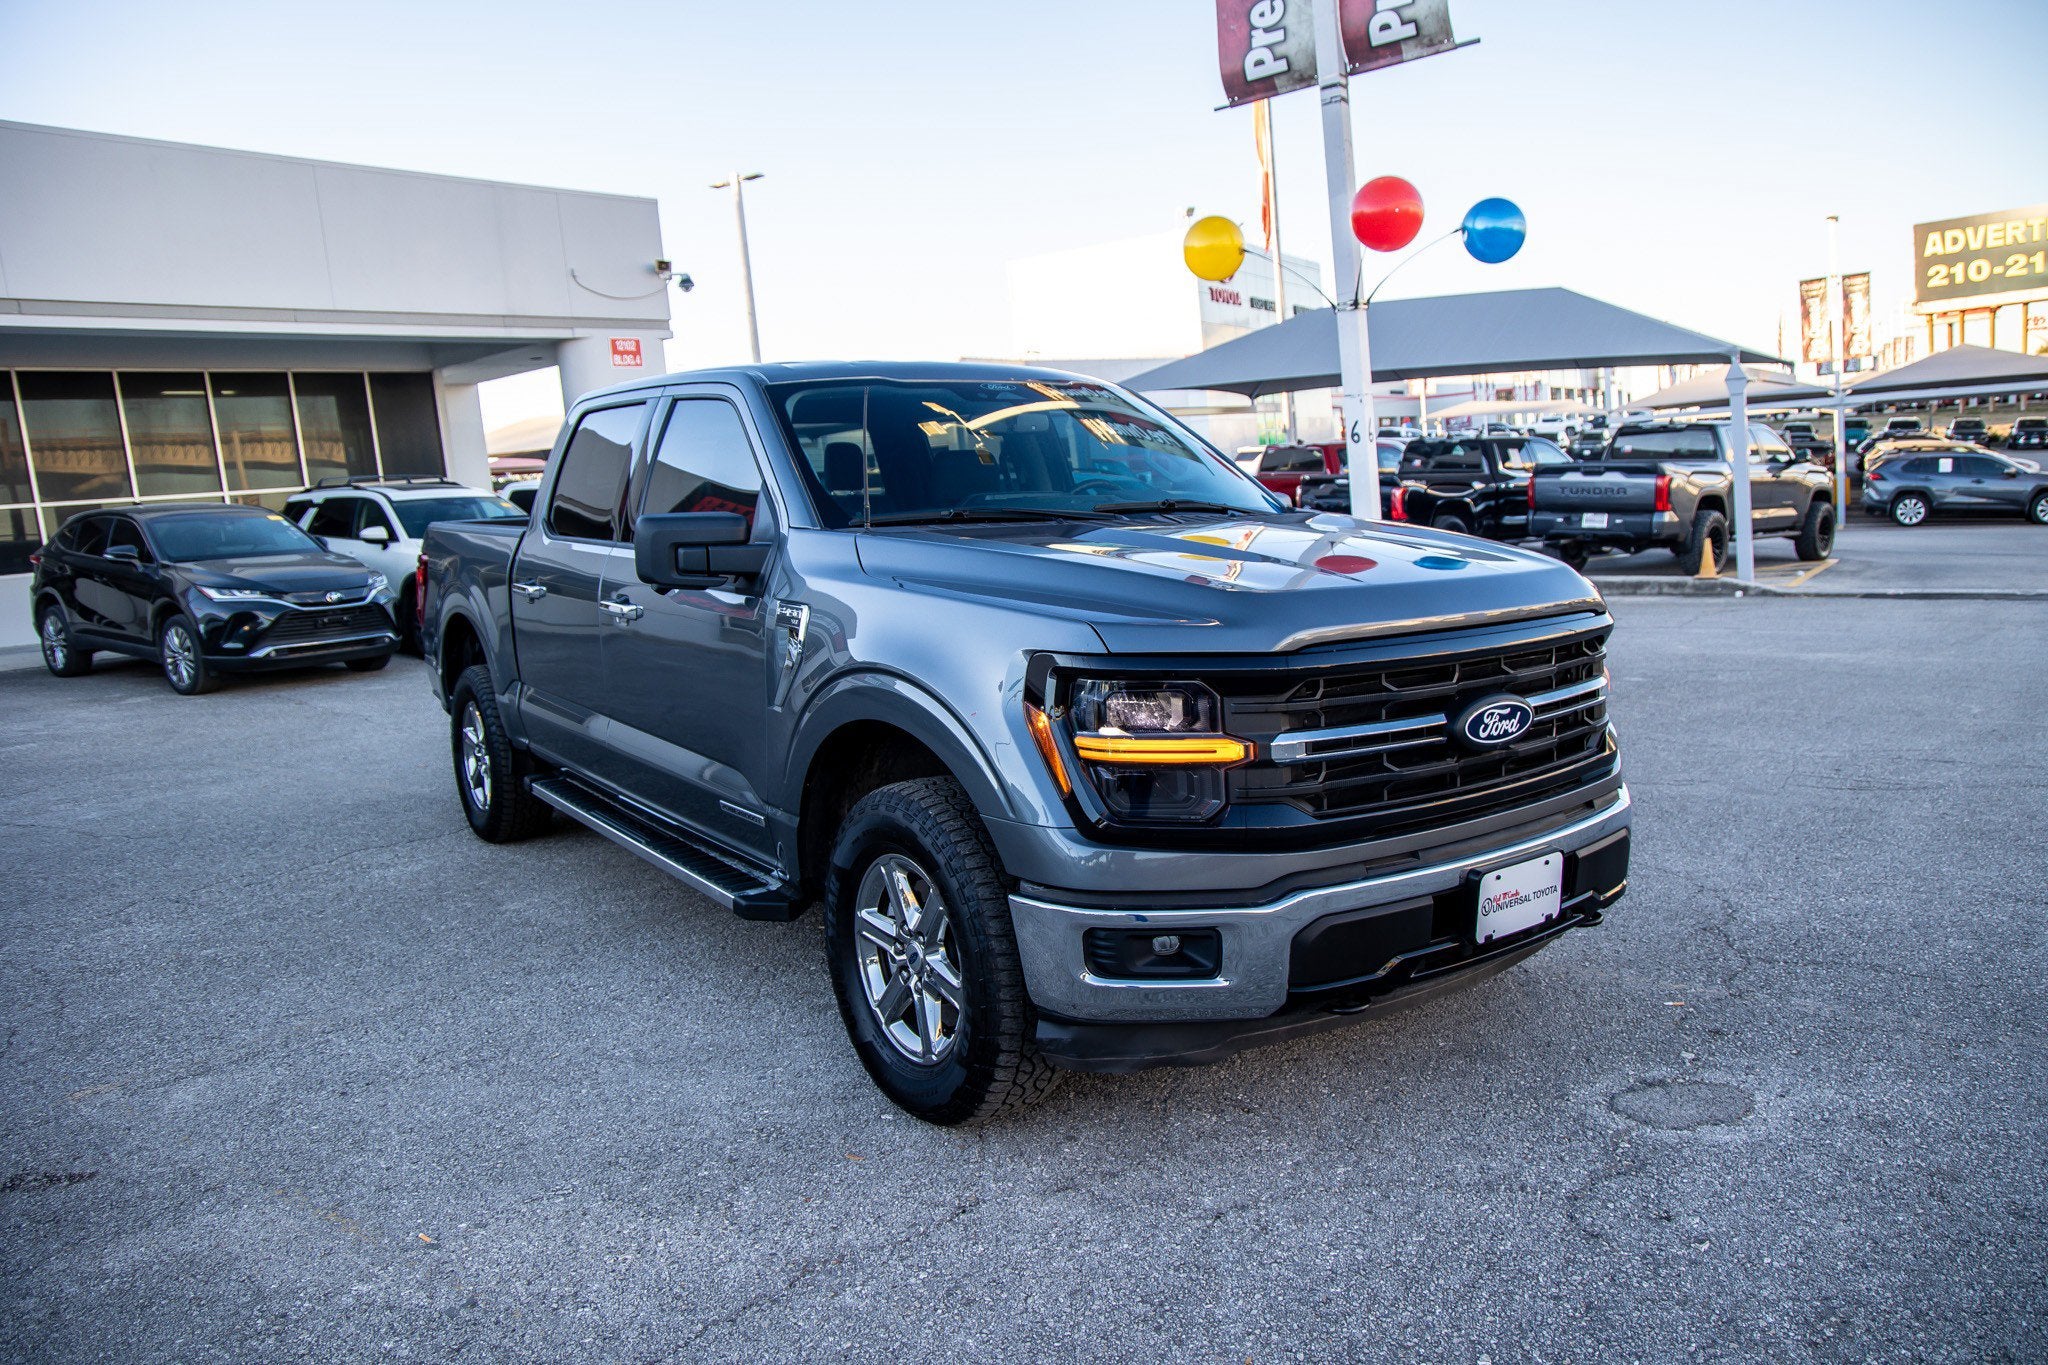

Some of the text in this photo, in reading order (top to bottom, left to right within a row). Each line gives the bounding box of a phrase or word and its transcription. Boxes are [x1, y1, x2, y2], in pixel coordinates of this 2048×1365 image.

[1923, 216, 2048, 258] ADVERT
[1926, 251, 2046, 288] 210-21
[1350, 419, 1360, 444] 6
[1559, 486, 1628, 496] TUNDRA
[1479, 706, 1521, 739] Ford
[1492, 885, 1558, 913] UNIVERSAL TOYOTA
